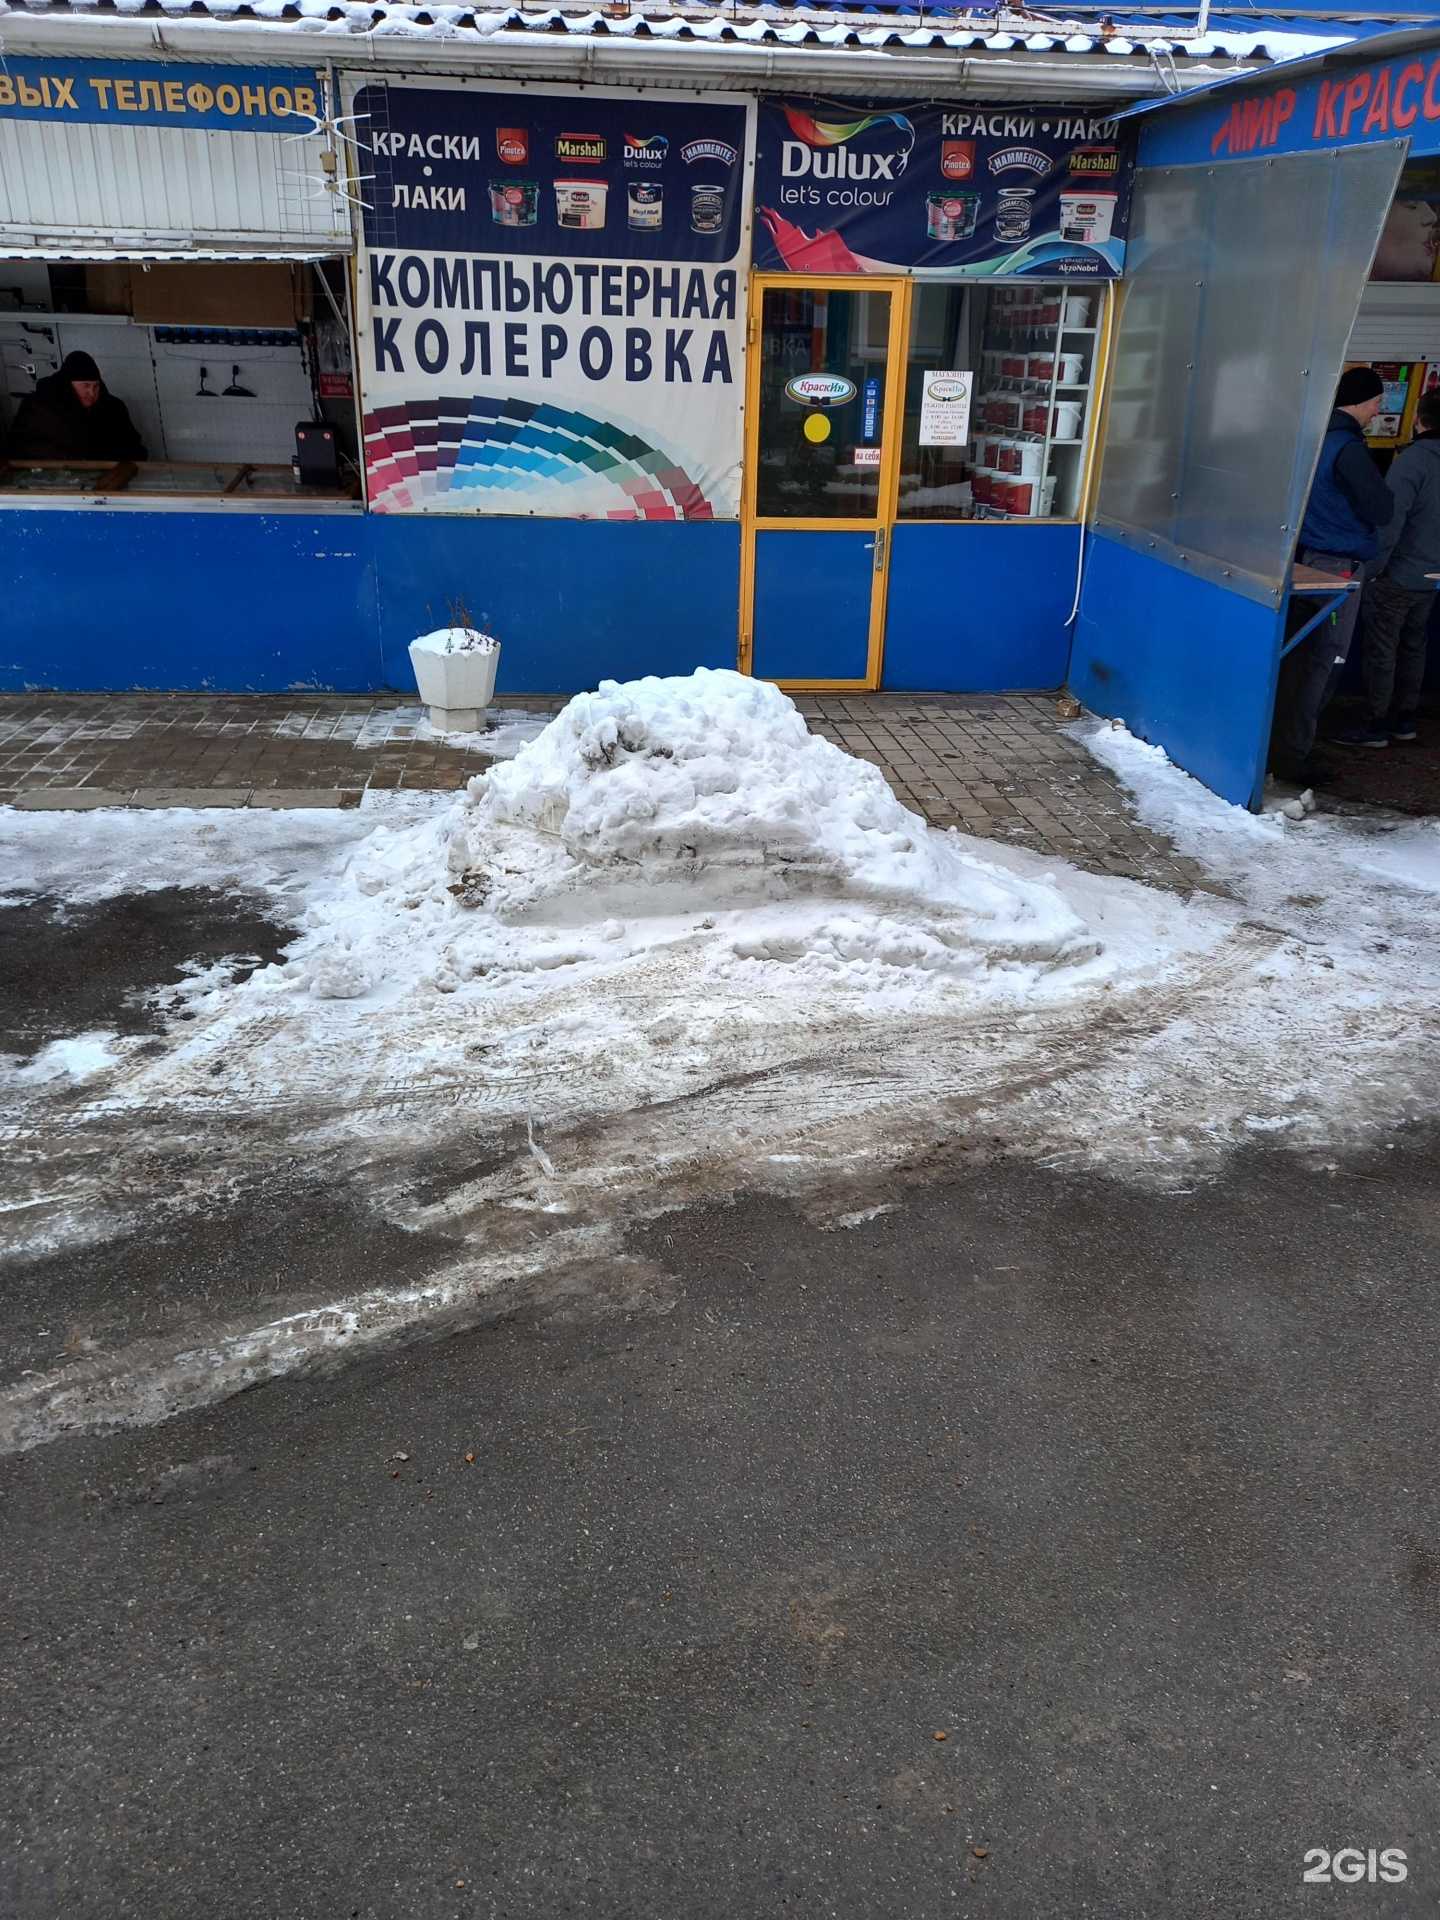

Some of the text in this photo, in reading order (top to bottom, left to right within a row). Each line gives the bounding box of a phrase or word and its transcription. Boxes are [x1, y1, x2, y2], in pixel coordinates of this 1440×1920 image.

[89, 78, 317, 118] ТЕЛЕФОНОВ
[942, 113, 1120, 140] КРАСКИ ЛАКИ
[1211, 88, 1297, 156] МИР
[371, 131, 481, 161] КРАСКИ
[557, 140, 604, 157] Marshall
[623, 145, 662, 160] Dulux
[686, 143, 732, 161] HAMMERITE
[781, 140, 896, 180] Dulux
[994, 151, 1048, 172] HAMMERITE
[1068, 153, 1118, 171] Marshall
[391, 184, 466, 211] ЛАКИ
[780, 185, 895, 207] let's colour
[369, 254, 737, 320] КОМПЬЮТЕРНАЯ
[373, 317, 733, 384] КОЛЕРОВКА
[800, 381, 845, 393] КраскИн
